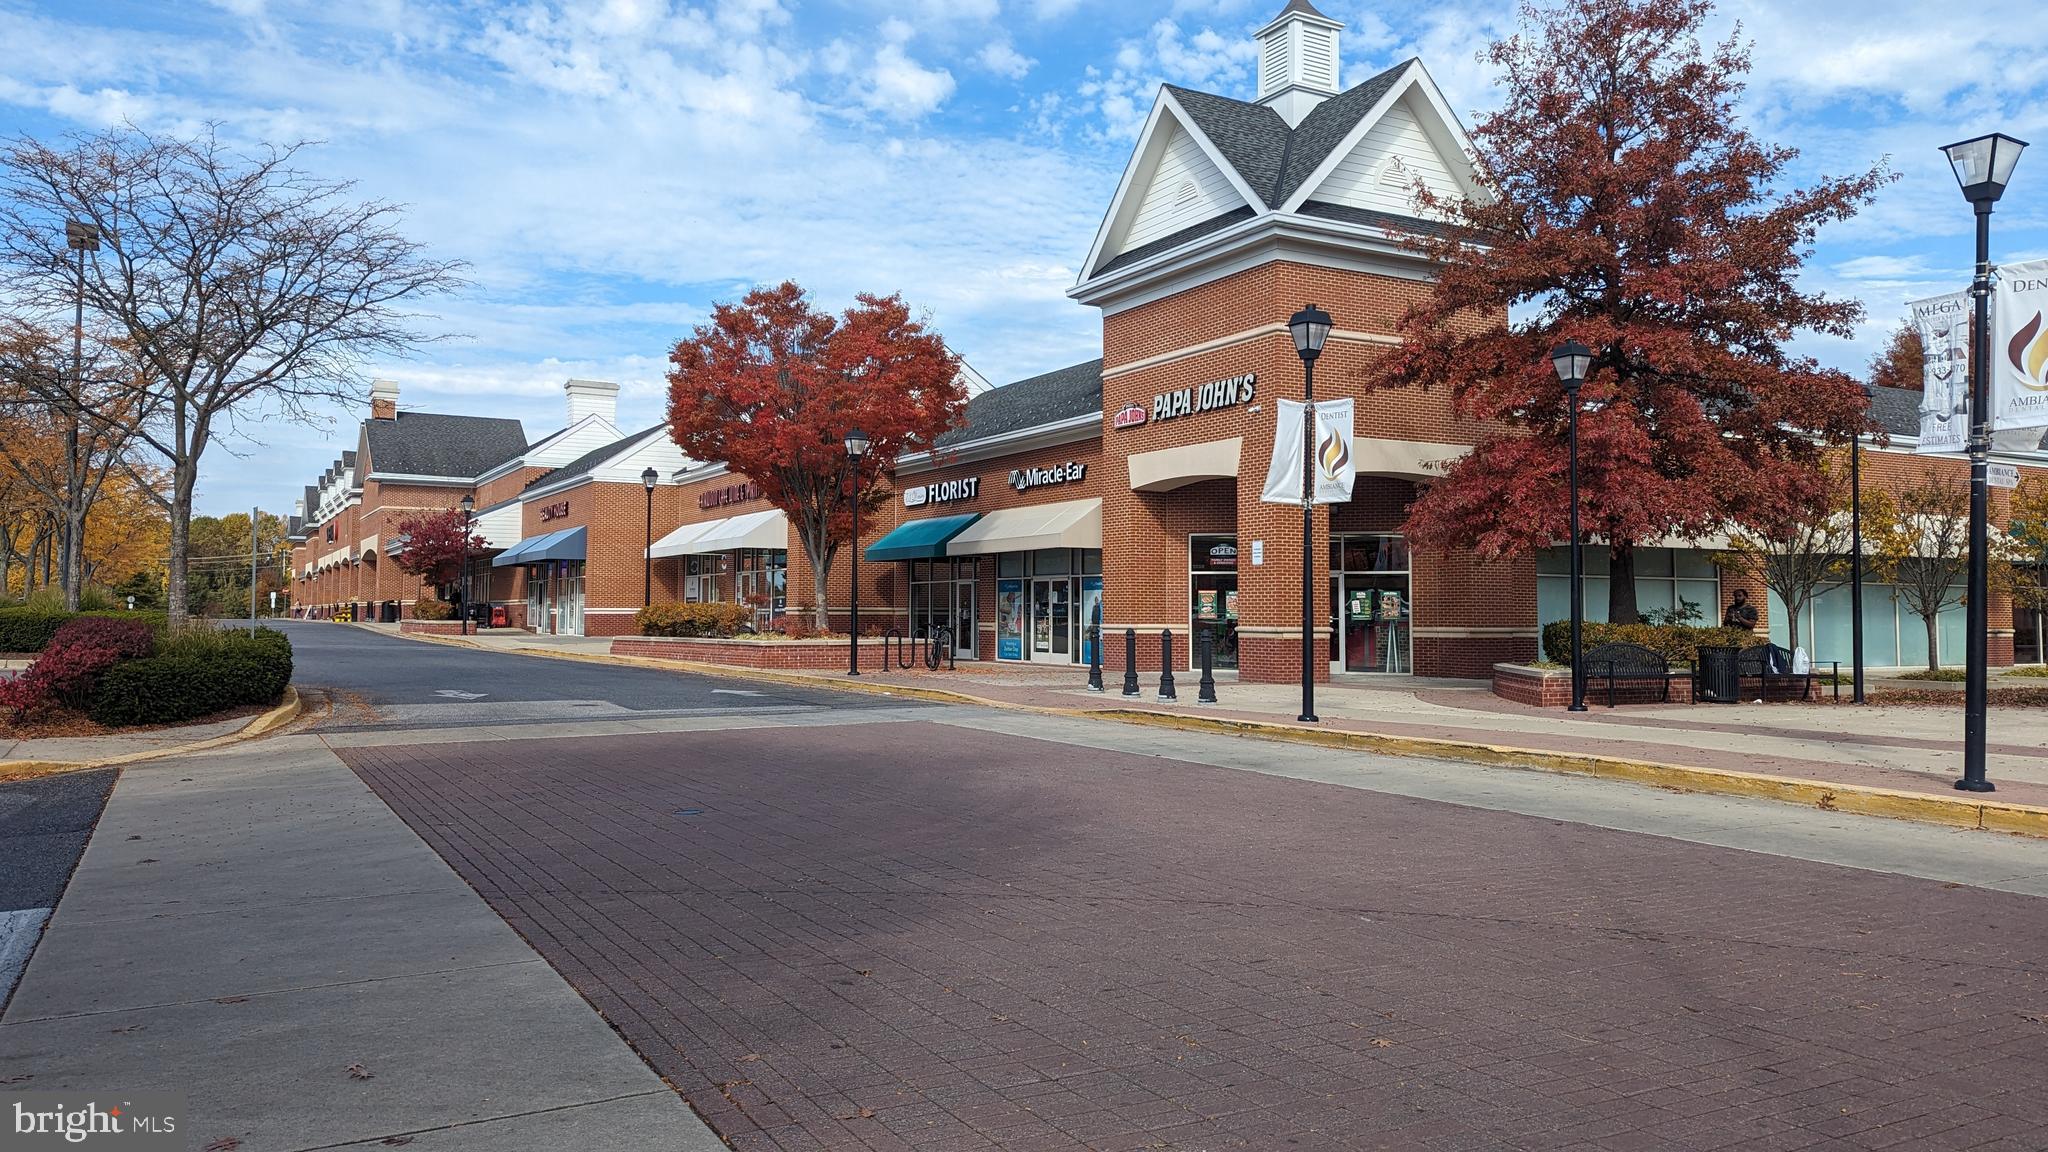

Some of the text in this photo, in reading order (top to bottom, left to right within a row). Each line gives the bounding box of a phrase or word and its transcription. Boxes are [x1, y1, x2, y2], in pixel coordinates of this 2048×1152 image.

[1918, 299, 1961, 316] MEGA
[1152, 373, 1255, 421] PAPA JOHN'S
[1115, 411, 1128, 425] PAPA
[1320, 410, 1348, 420] DENTIST
[1931, 423, 1952, 432] FREE
[1921, 434, 1961, 446] ESTIMATES
[1026, 462, 1085, 487] Miracle-Ear
[1989, 466, 2014, 478] AMBIANCE
[928, 477, 978, 503] FLORIST
